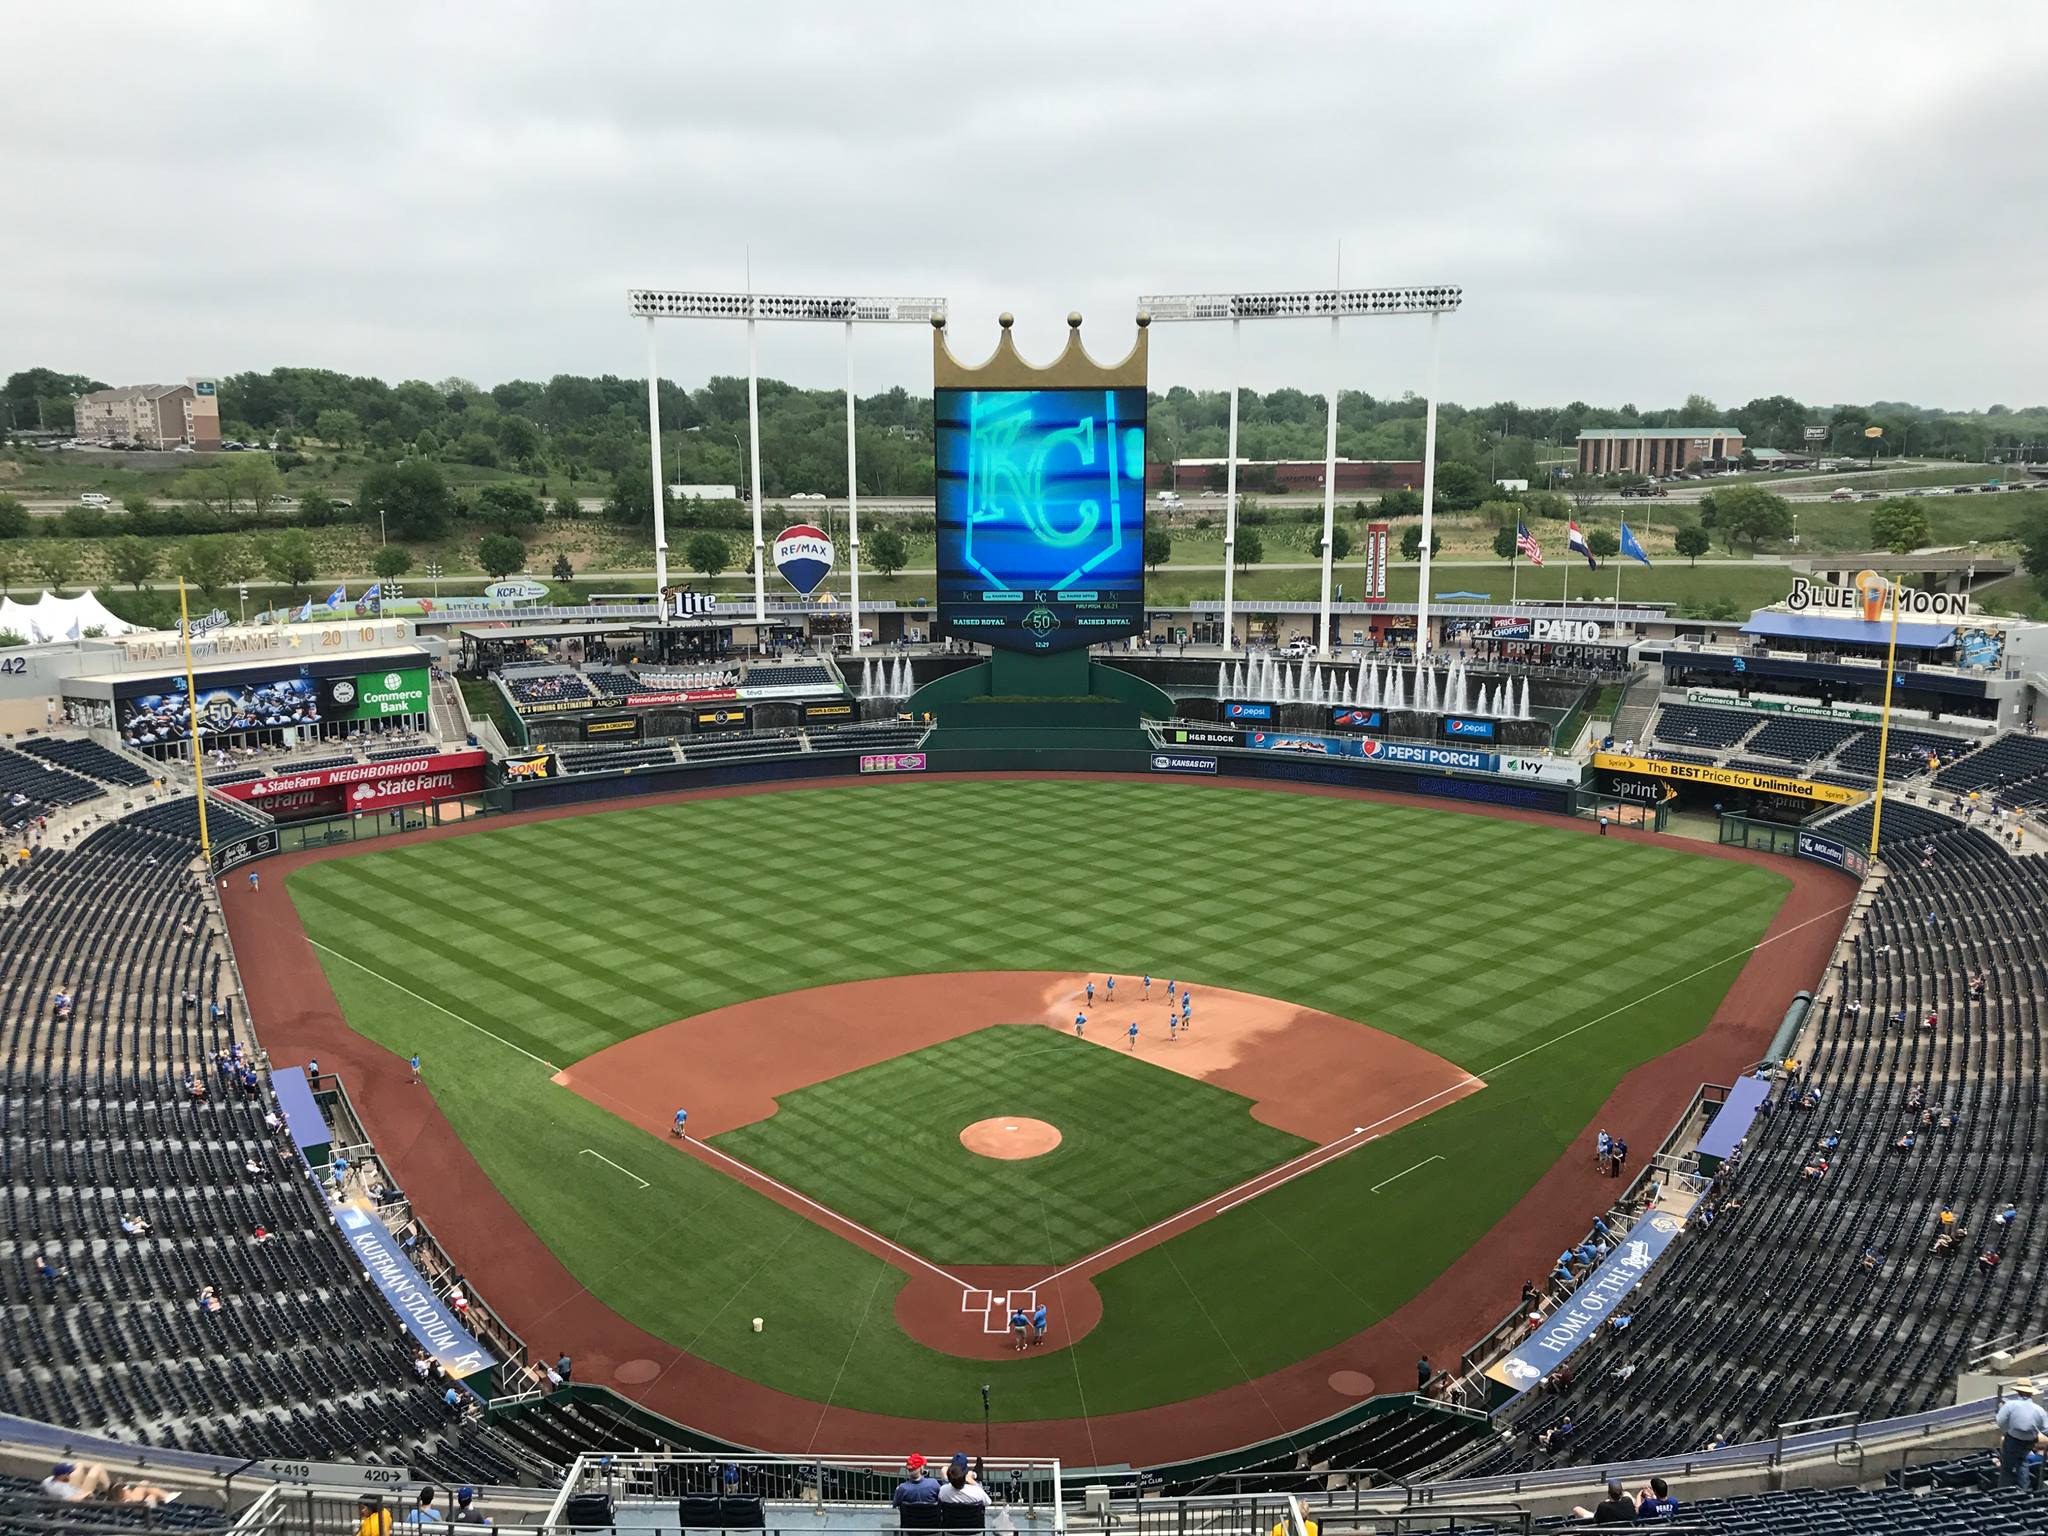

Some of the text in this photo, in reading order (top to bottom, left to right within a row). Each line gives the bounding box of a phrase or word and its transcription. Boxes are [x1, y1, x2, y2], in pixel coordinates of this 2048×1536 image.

[781, 543, 827, 557] RE/MAX
[1035, 590, 1047, 603] KC
[1787, 578, 1969, 616] BLUE MOON
[674, 592, 716, 619] Lite
[1033, 615, 1050, 629] 50
[1078, 618, 1105, 626] RAISED
[1494, 617, 1517, 628] PRICE
[359, 627, 375, 642] 10
[395, 624, 406, 640] 5
[1493, 625, 1530, 637] CHOPPER
[1534, 619, 1600, 643] PATIO
[216, 632, 281, 656] FAME
[321, 630, 342, 647] 20
[1, 657, 27, 675] 42
[364, 690, 423, 703] Commerce
[1698, 695, 1753, 708] Commerce Bank
[209, 703, 233, 721] 50
[381, 701, 409, 713] Bank
[1244, 708, 1266, 717] pepsi
[1792, 704, 1851, 719] Commerce Bank
[1464, 723, 1487, 734] pepsi
[1207, 735, 1234, 743] BLOCK
[1388, 745, 1479, 768] PEPSI PORCH
[510, 762, 546, 774] SONIC
[1171, 759, 1199, 768] KANSAS
[1199, 761, 1216, 769] CITY
[1521, 760, 1543, 774] Ivy
[329, 760, 429, 783] NEIGHBORHOOD
[1608, 759, 1844, 800] Sprint The BEST Price for Unlimited Sprint
[1611, 777, 1658, 800] Sprint
[353, 1231, 460, 1351] KAUFFMAN STADIUM
[1540, 1240, 1653, 1353] HOME OF THE Royals
[284, 1465, 310, 1477] 419
[364, 1469, 390, 1483] 420
